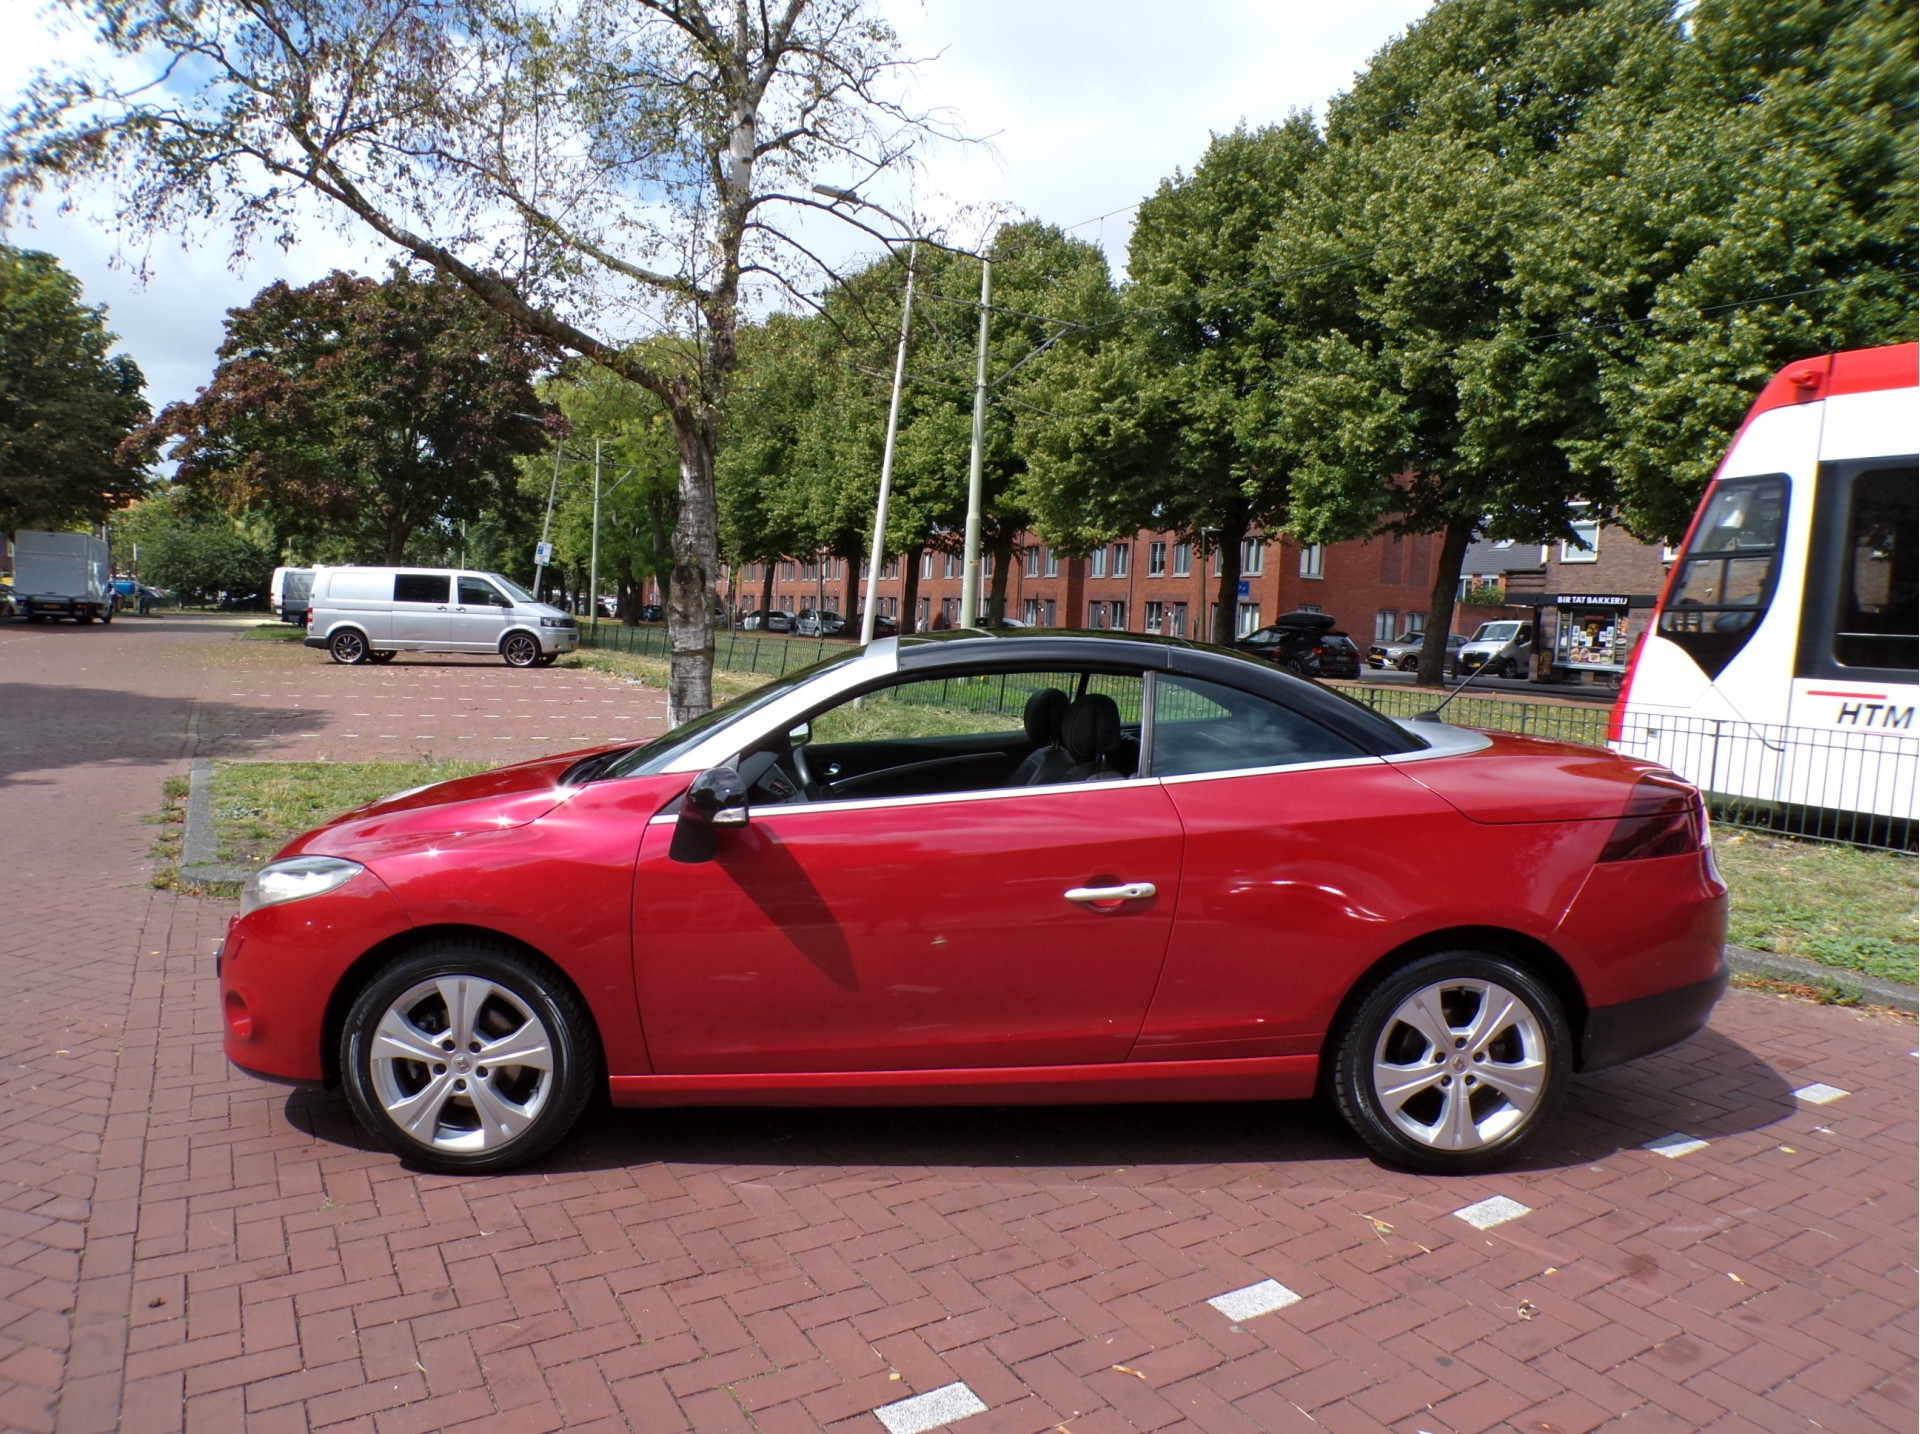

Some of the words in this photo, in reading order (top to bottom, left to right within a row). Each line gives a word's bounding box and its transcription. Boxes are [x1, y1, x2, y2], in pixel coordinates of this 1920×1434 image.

[1572, 596, 1586, 604] TAT
[1587, 596, 1628, 605] BAKKERIJ
[1836, 702, 1915, 729] HTM
